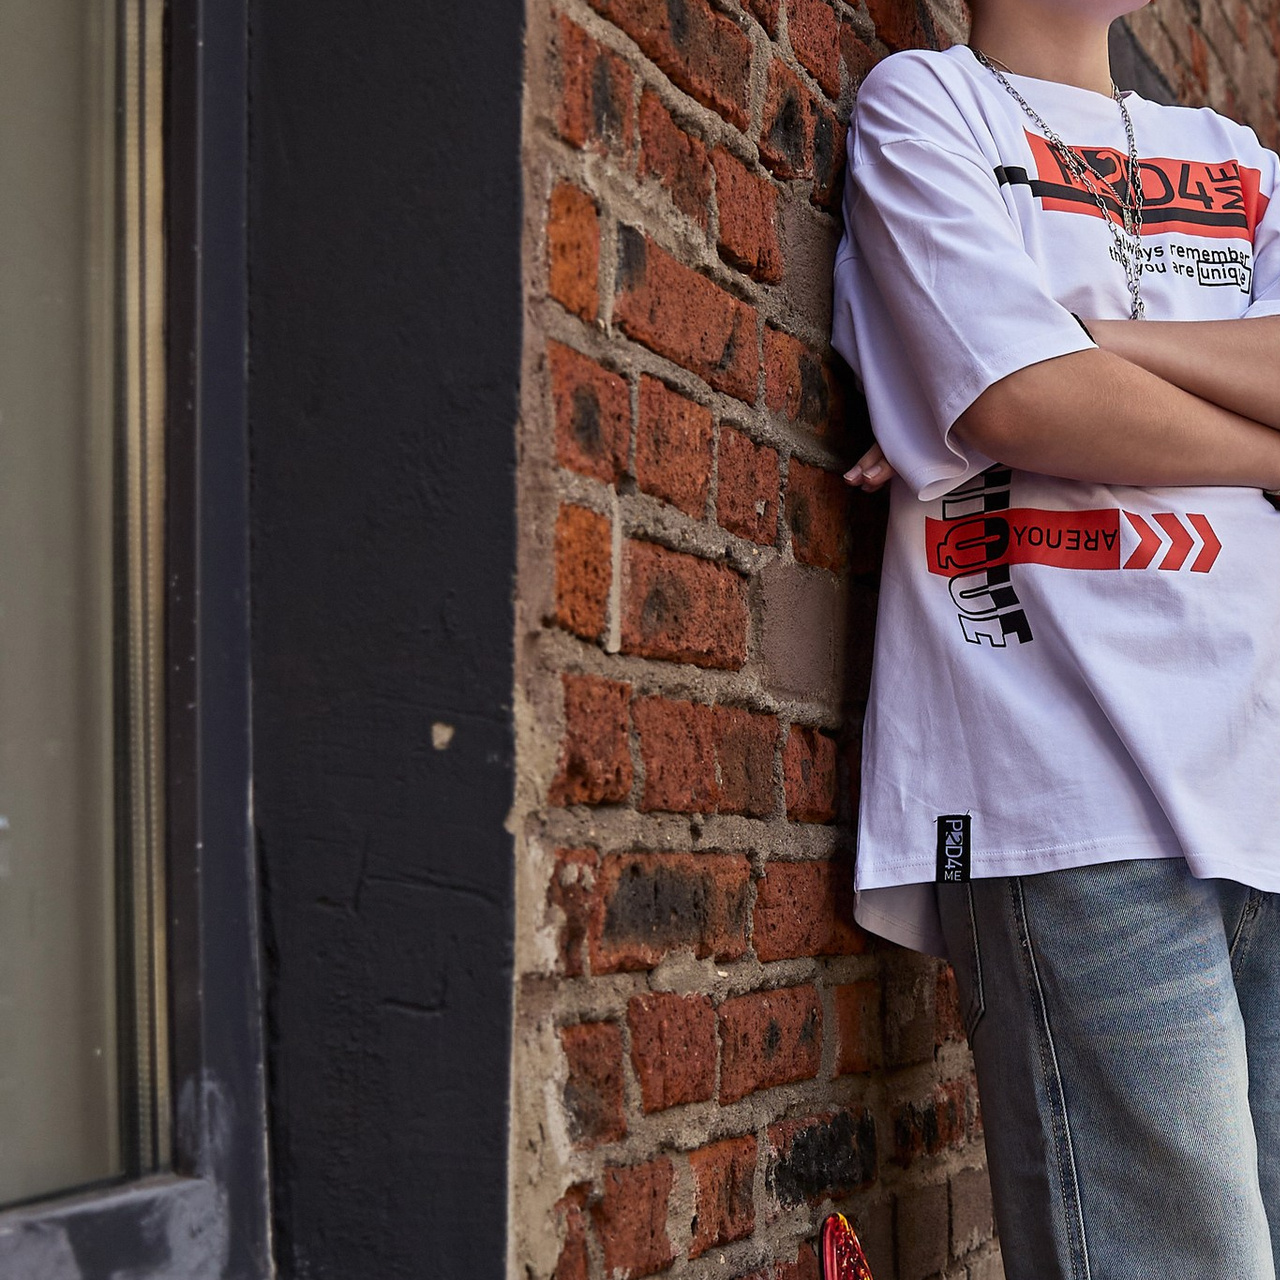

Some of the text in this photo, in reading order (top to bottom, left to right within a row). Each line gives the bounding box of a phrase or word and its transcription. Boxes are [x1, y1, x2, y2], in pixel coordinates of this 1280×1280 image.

[1205, 163, 1239, 210] ME
[1169, 243, 1250, 267] remember
[1172, 261, 1195, 278] are
[944, 819, 963, 870] P2D4
[944, 870, 962, 882] ME
